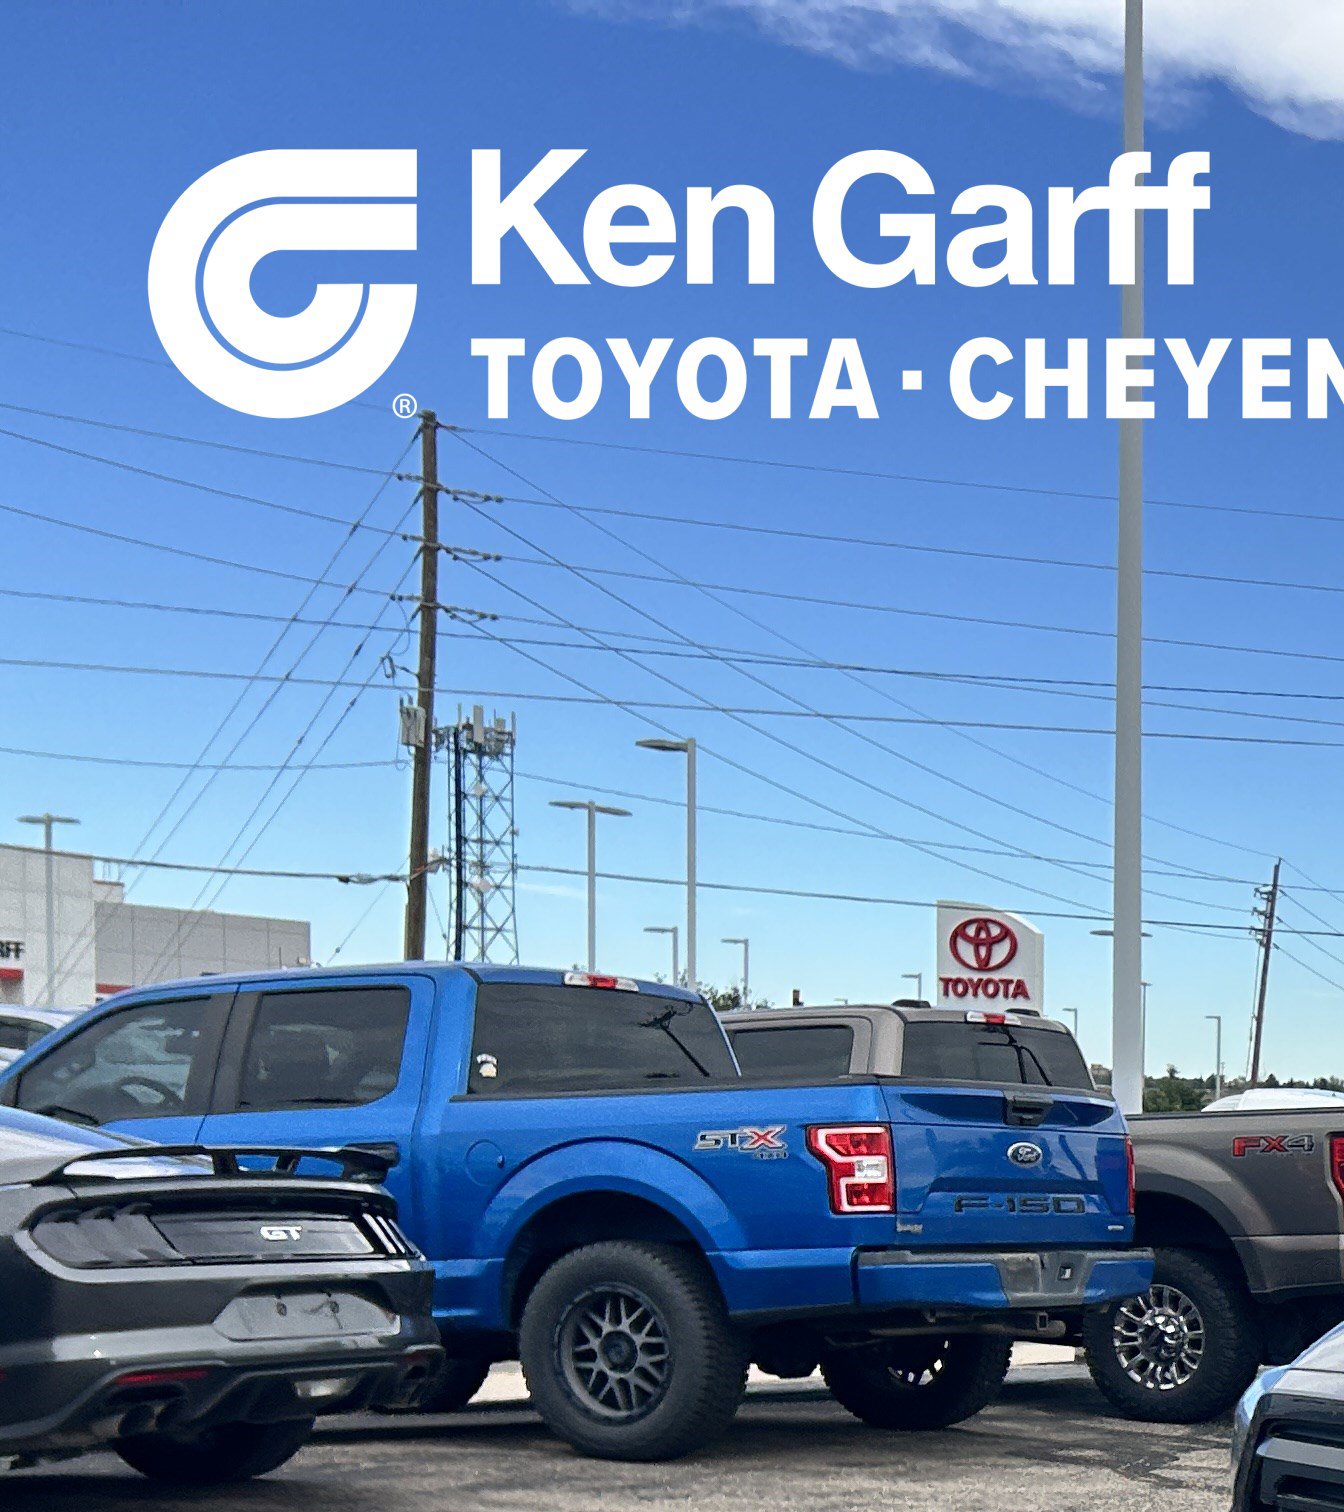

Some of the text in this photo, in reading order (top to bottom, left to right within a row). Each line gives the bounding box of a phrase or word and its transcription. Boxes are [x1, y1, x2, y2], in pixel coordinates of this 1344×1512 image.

[939, 977, 1030, 1000] TOYOTA
[694, 1125, 787, 1151] STX
[1232, 1134, 1314, 1157] FX4
[954, 1194, 1086, 1214] F-150
[260, 1226, 302, 1240] GT
